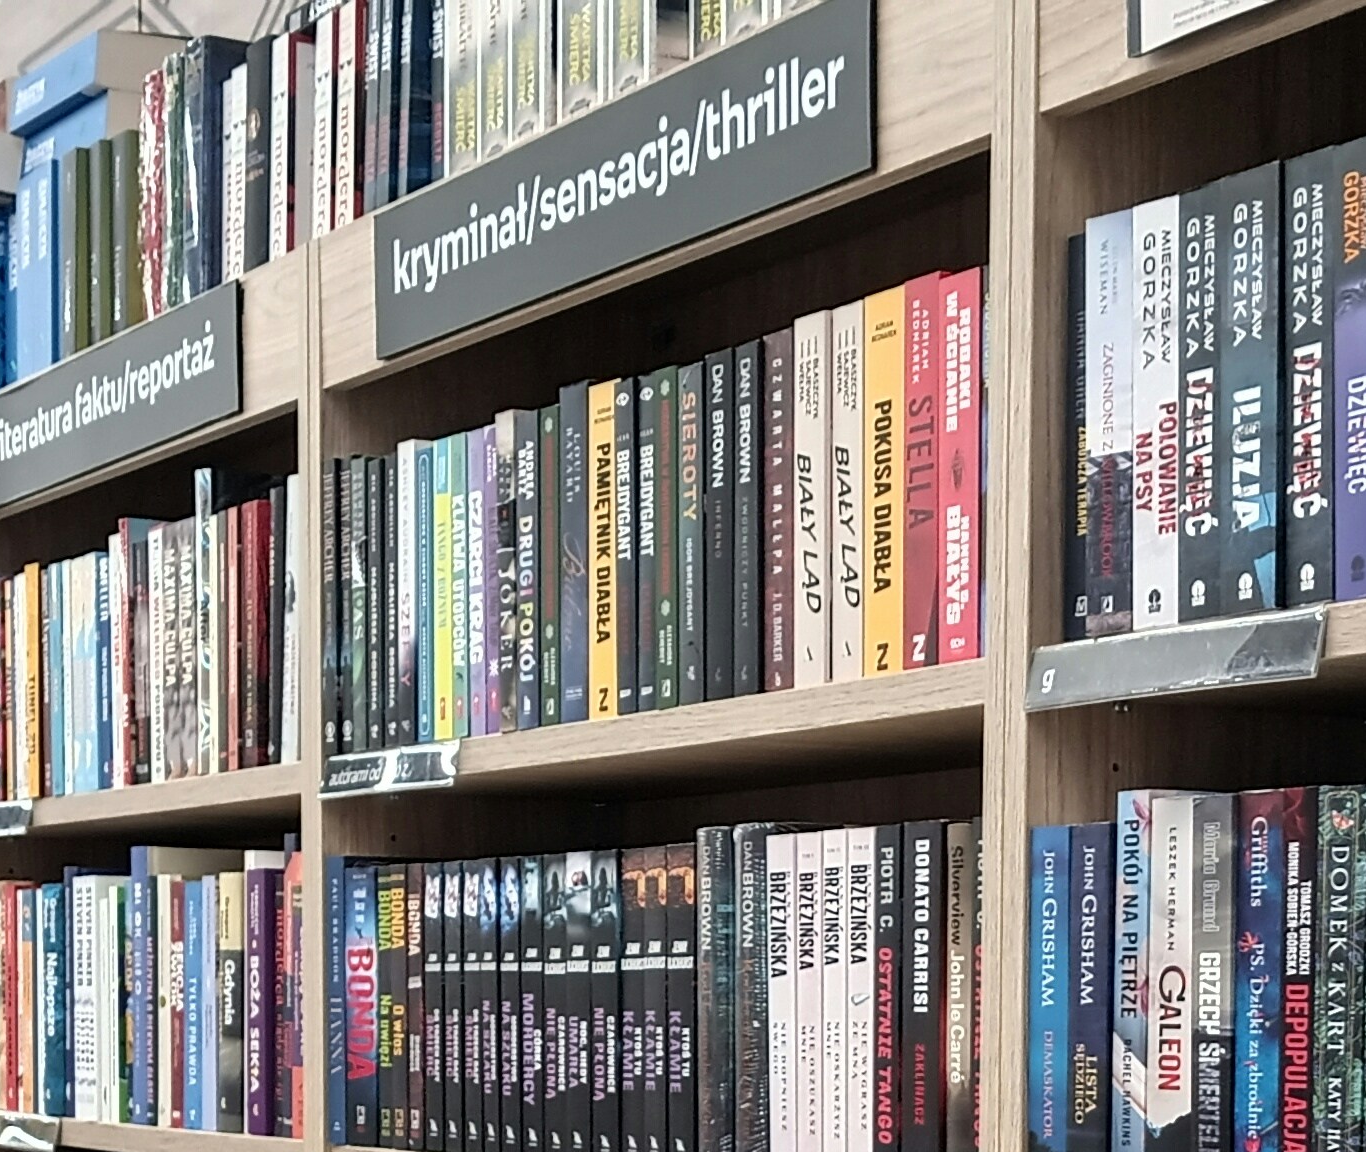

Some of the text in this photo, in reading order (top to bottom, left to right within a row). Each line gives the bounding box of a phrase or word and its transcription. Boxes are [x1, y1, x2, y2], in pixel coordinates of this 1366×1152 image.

[392, 53, 846, 294] kryminał/sensacja/thriller
[73, 320, 216, 430] faktu/reportaż
[834, 446, 861, 608] BIAŁY LĄD
[872, 399, 892, 593] POKUSA DIABŁA
[907, 395, 933, 529] STELLA
[223, 959, 235, 1025] Gdynia
[912, 839, 928, 1013] DONATO CARRISI
[1042, 852, 1058, 1007] JOHN GRISHAM
[247, 1027, 260, 1093] SEKTA
[347, 948, 376, 1081] BONDA
[1159, 965, 1186, 1092] GALEON
